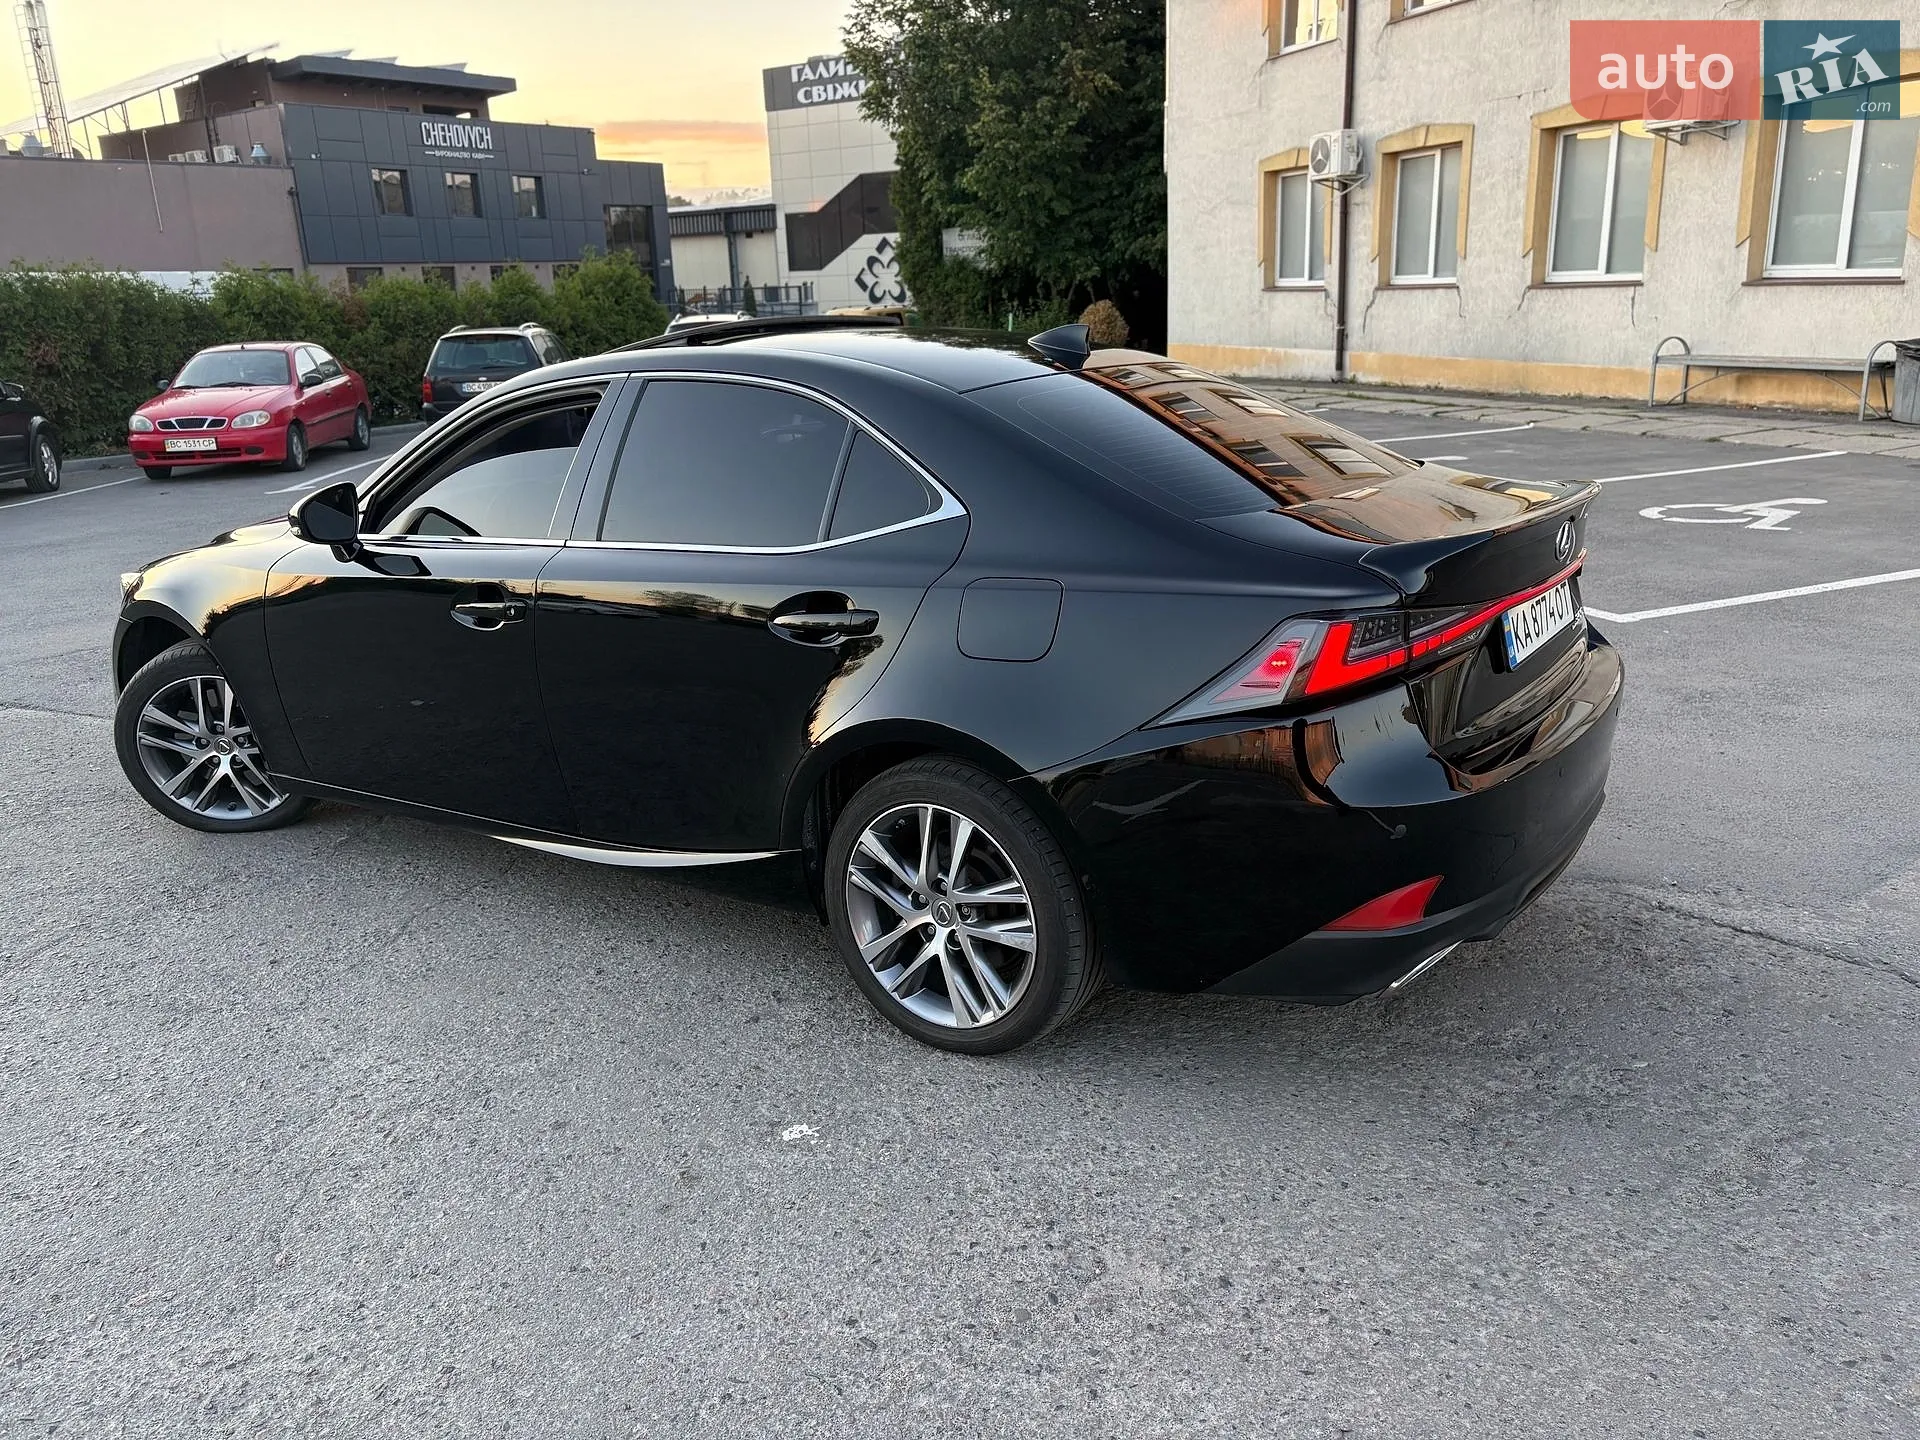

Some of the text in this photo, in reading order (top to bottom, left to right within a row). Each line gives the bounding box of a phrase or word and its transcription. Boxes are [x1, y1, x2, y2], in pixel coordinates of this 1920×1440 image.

[421, 121, 493, 150] CHEHOVYCH
[170, 439, 215, 449] BC 1531 CP
[1511, 609, 1534, 654] KA
[1530, 591, 1557, 639] 8774
